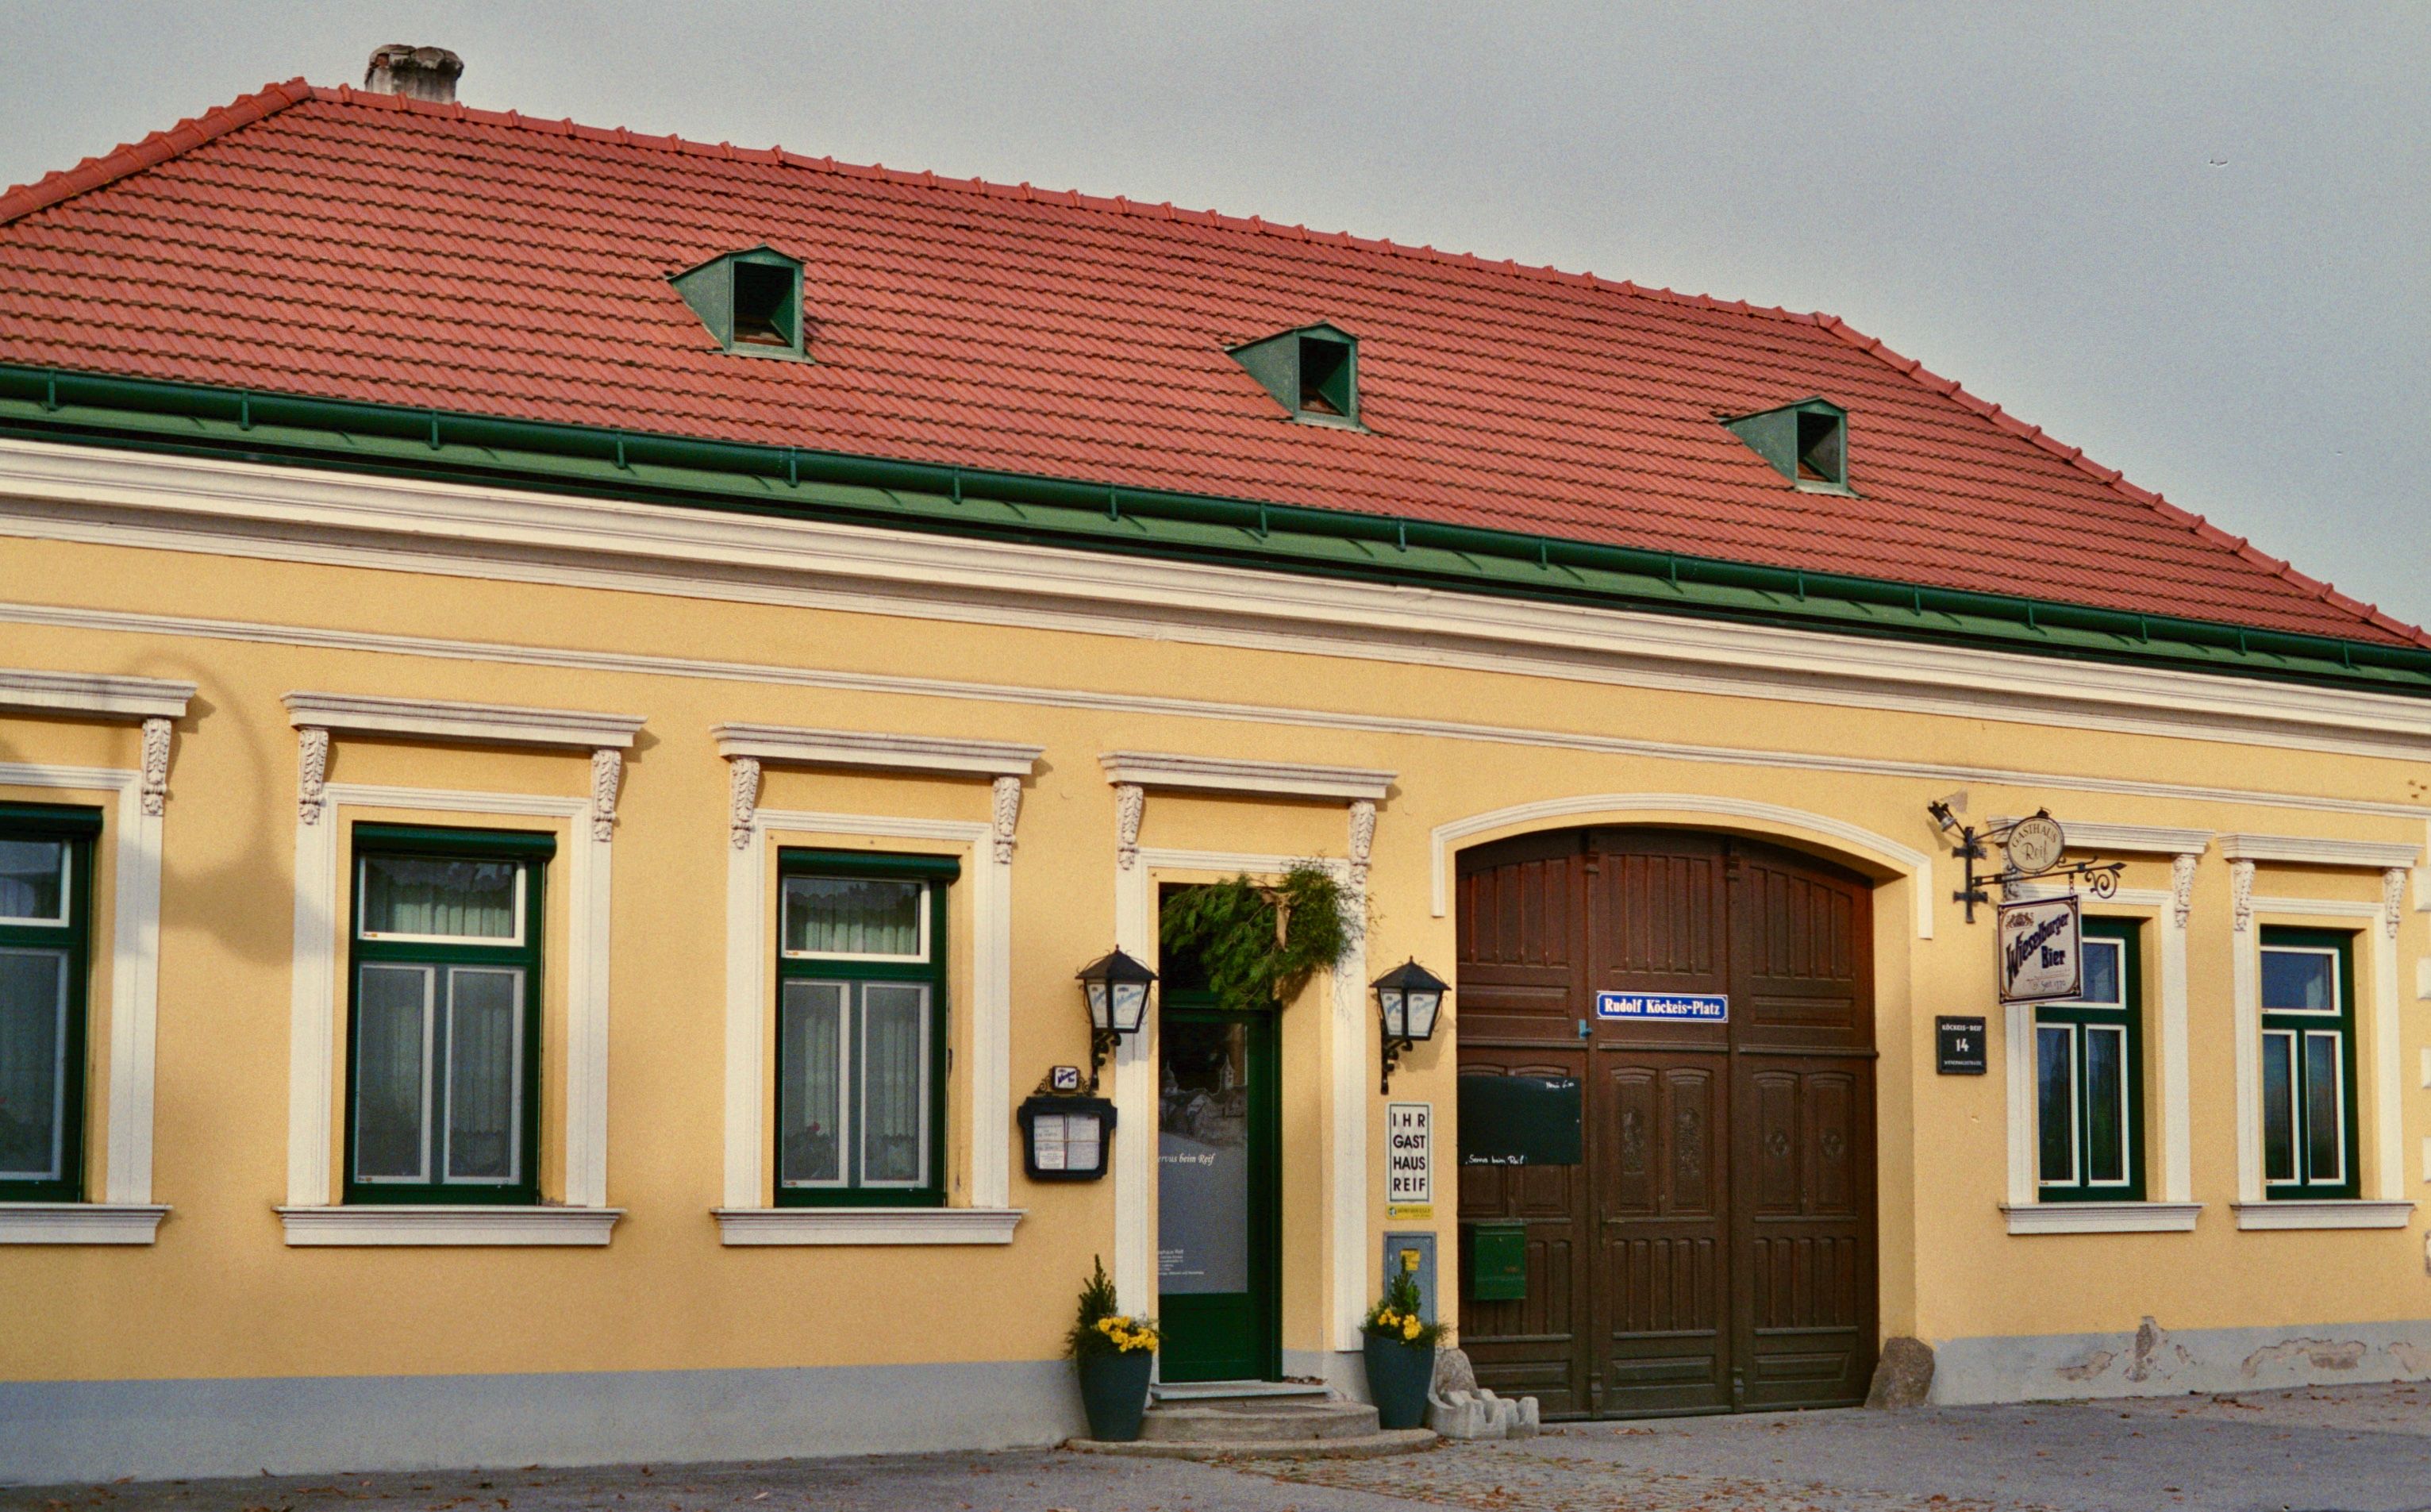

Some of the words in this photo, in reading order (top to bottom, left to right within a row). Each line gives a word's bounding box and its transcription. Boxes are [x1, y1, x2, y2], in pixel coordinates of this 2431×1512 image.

[2011, 823, 2058, 848] GASTHAUS
[2021, 840, 2048, 864] Reif
[2005, 912, 2070, 994] Wieselburger
[2041, 945, 2066, 969] Bier
[1604, 998, 1643, 1014] Rudolf
[1646, 998, 1721, 1016] Köckeis-Platz
[1956, 1038, 1971, 1052] 14
[1392, 1113, 1426, 1128] IHR
[1392, 1134, 1426, 1149] GAST
[1158, 1155, 1178, 1164] ervus
[1179, 1152, 1196, 1164] beim
[1198, 1152, 1217, 1167] Reif
[1393, 1156, 1426, 1171] HAUS
[1393, 1177, 1426, 1192] REIF
